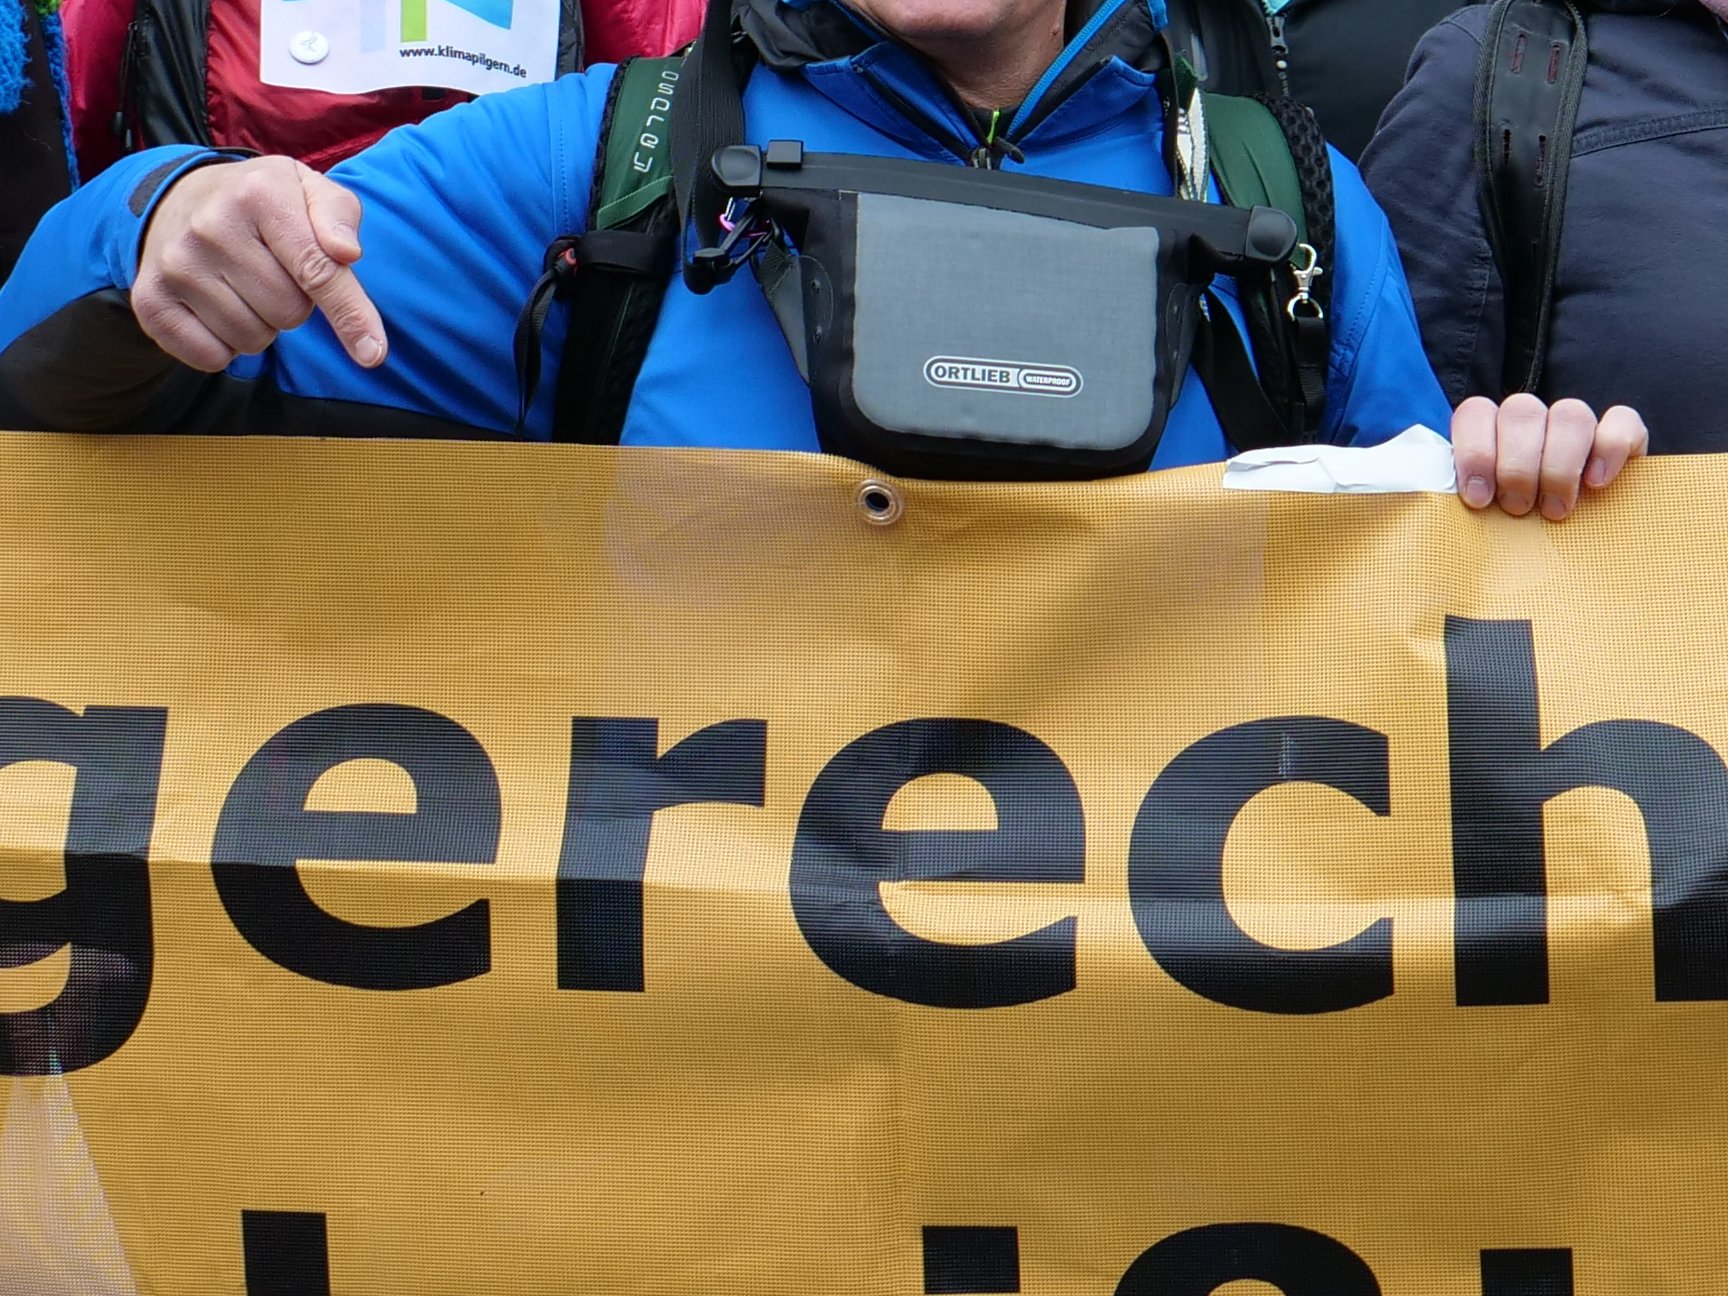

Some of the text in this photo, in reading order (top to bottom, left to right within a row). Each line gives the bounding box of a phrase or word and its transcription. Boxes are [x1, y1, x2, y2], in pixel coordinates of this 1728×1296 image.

[399, 45, 527, 78] www.klimapilgern.de
[633, 70, 680, 173] osprey
[934, 365, 1071, 386] ORTLIEB WATERPROOF
